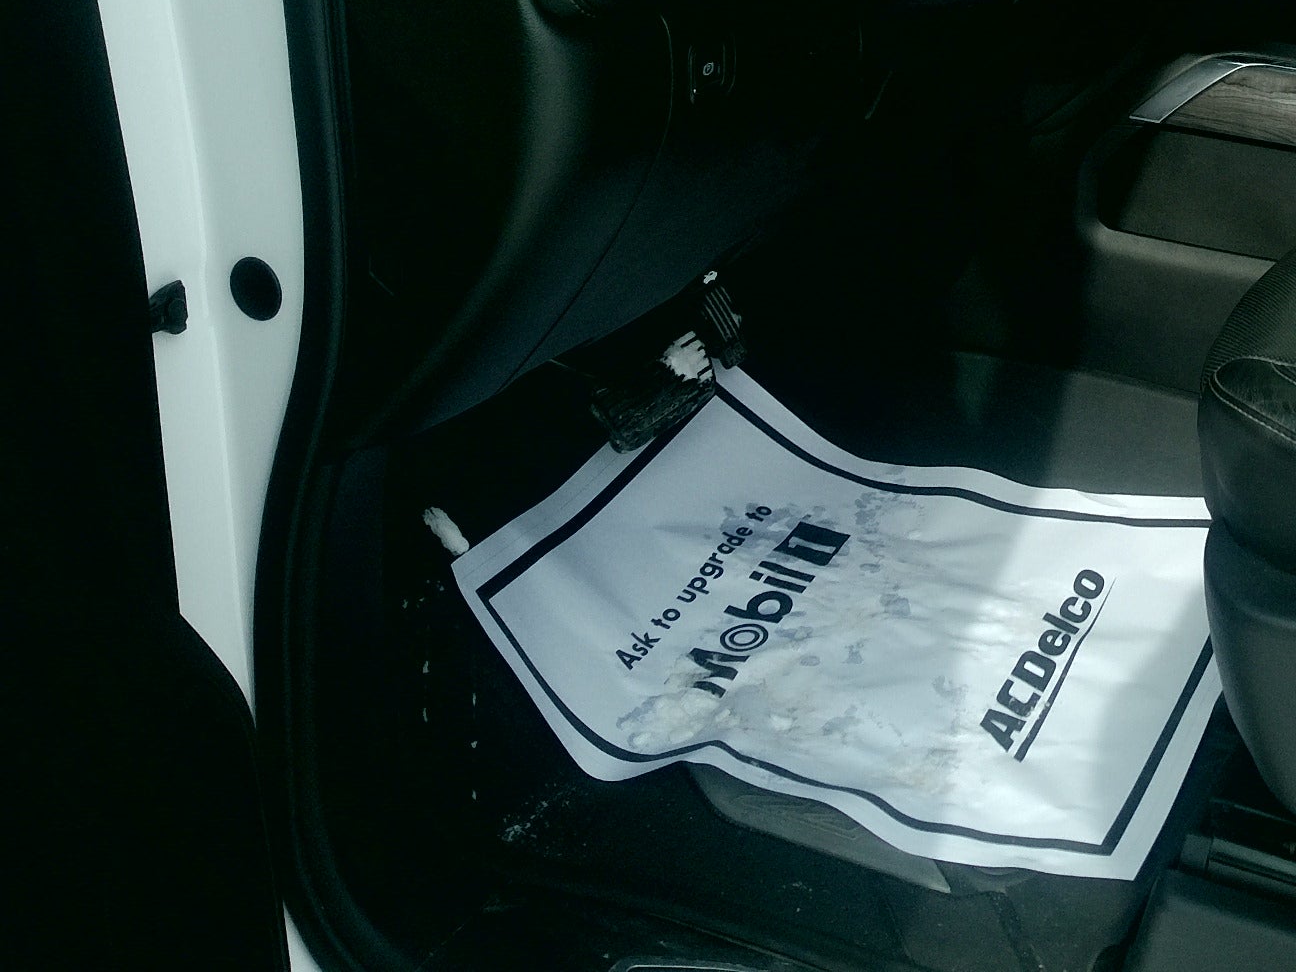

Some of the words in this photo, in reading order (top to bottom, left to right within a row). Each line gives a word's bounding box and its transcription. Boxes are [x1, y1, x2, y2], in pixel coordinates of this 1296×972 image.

[615, 631, 661, 670] Ask
[650, 608, 681, 630] to
[676, 529, 754, 605] upgrade
[745, 505, 773, 523] to
[979, 569, 1106, 754] ACDelco
